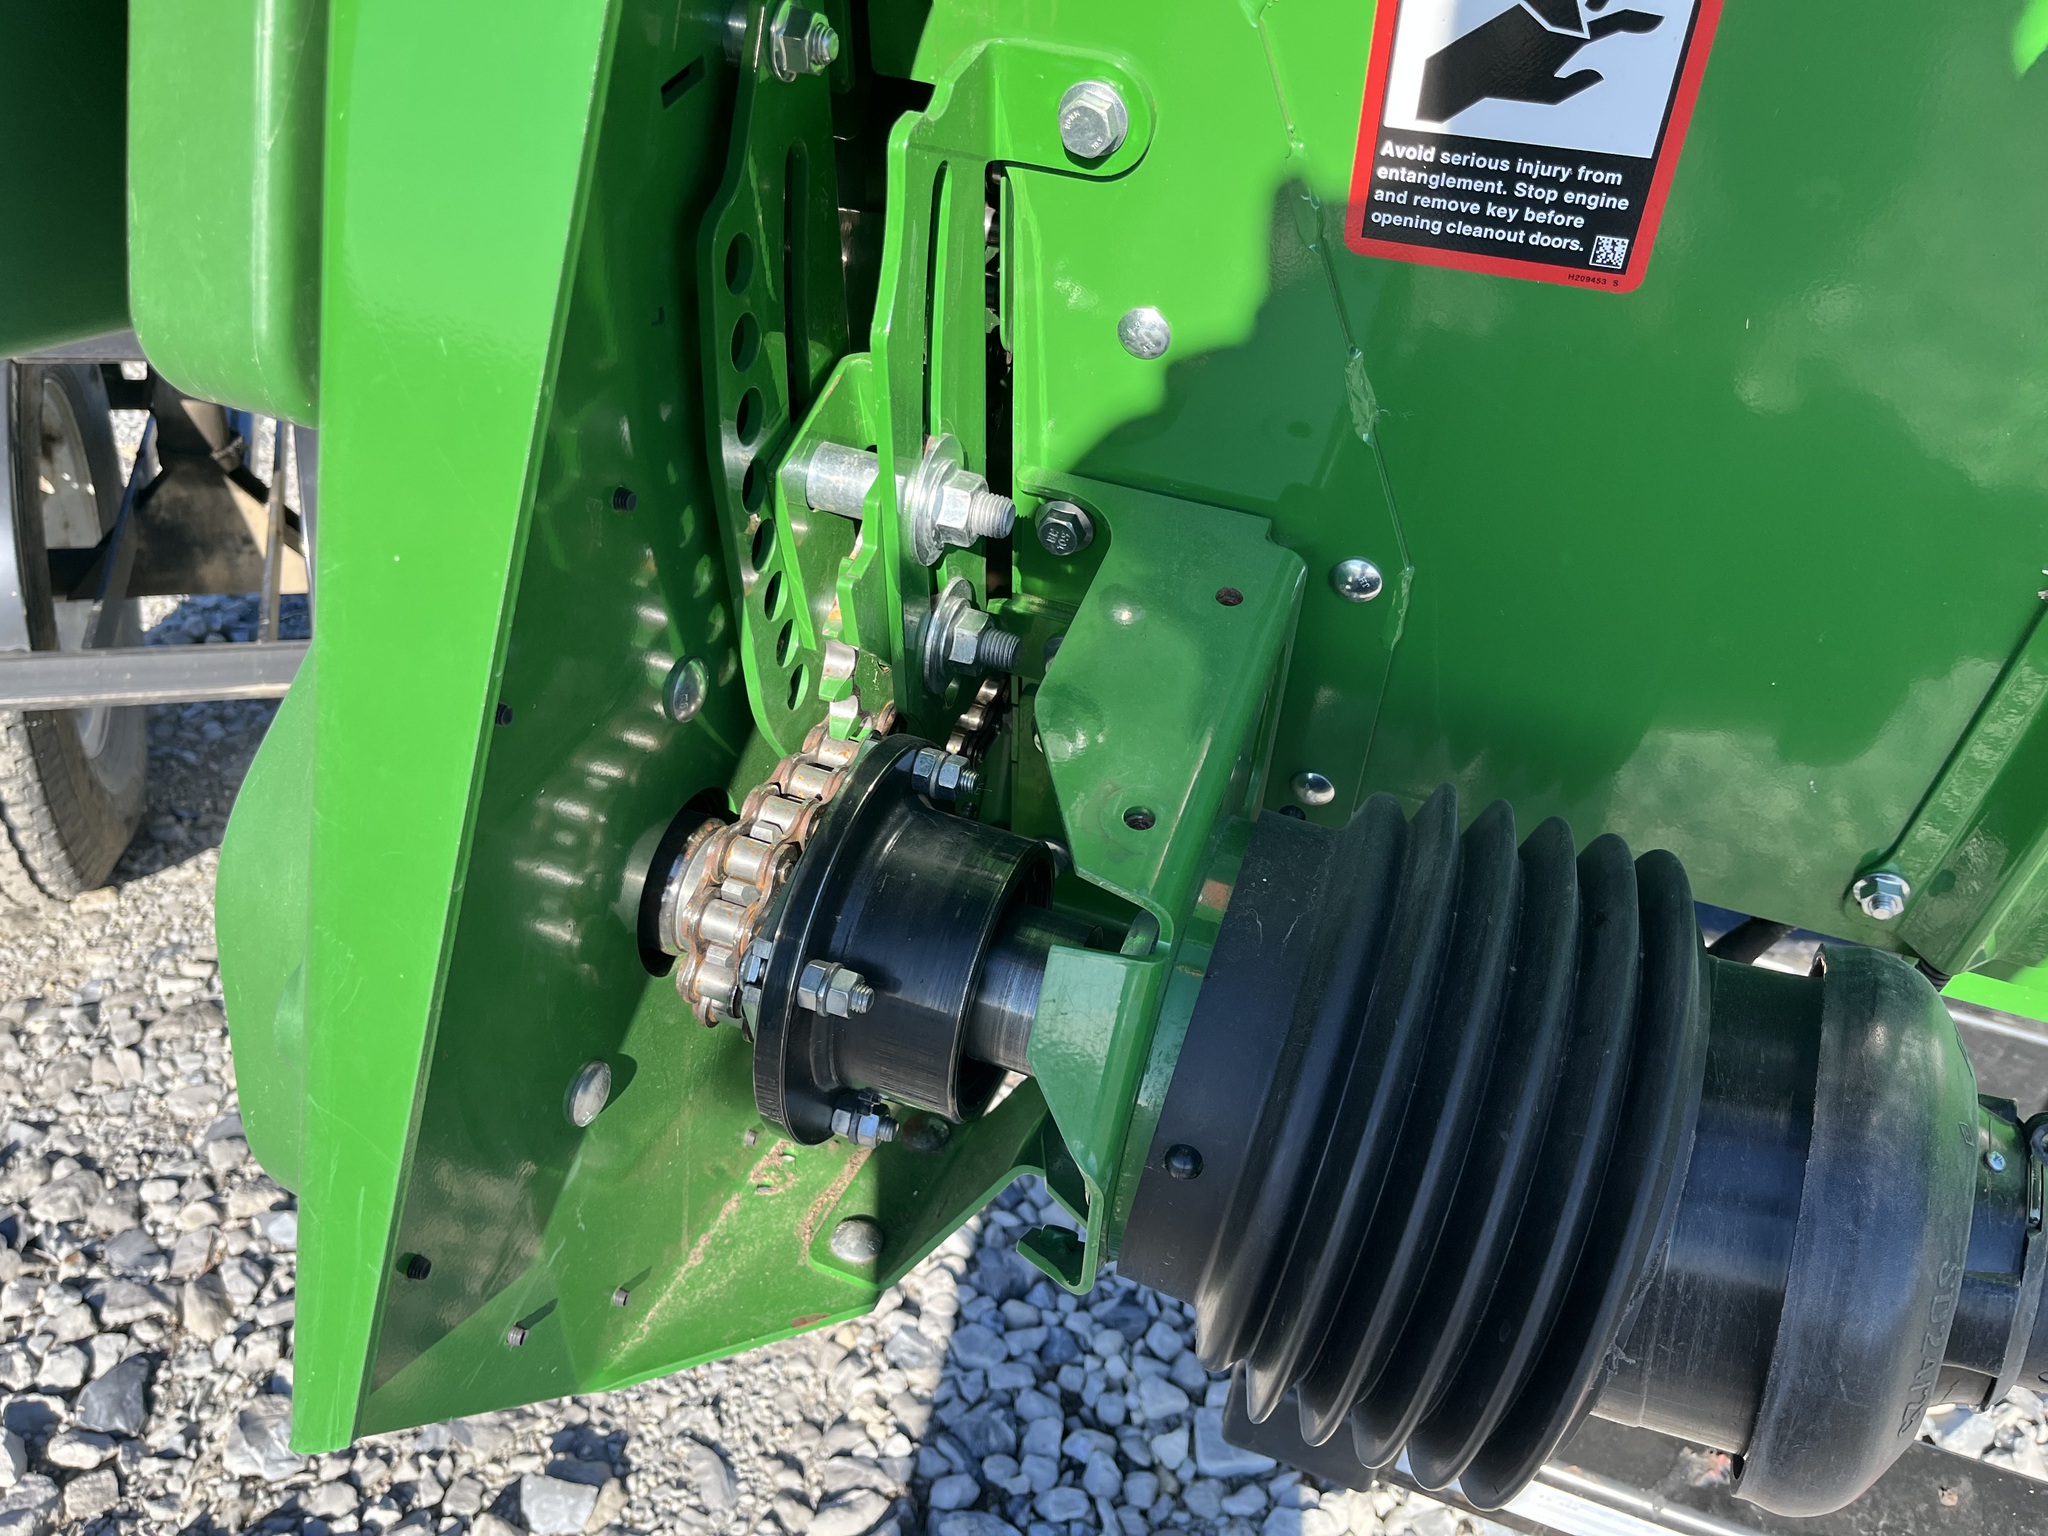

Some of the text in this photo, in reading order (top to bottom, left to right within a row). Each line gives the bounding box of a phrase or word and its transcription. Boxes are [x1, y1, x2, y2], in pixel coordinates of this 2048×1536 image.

[1380, 140, 1622, 185] Avoid serious injury from
[1376, 166, 1629, 210] entanglement. Stop engine
[1374, 189, 1584, 228] and remove key before
[1371, 212, 1583, 251] opening cleanout doors.
[1567, 273, 1608, 285] H209453
